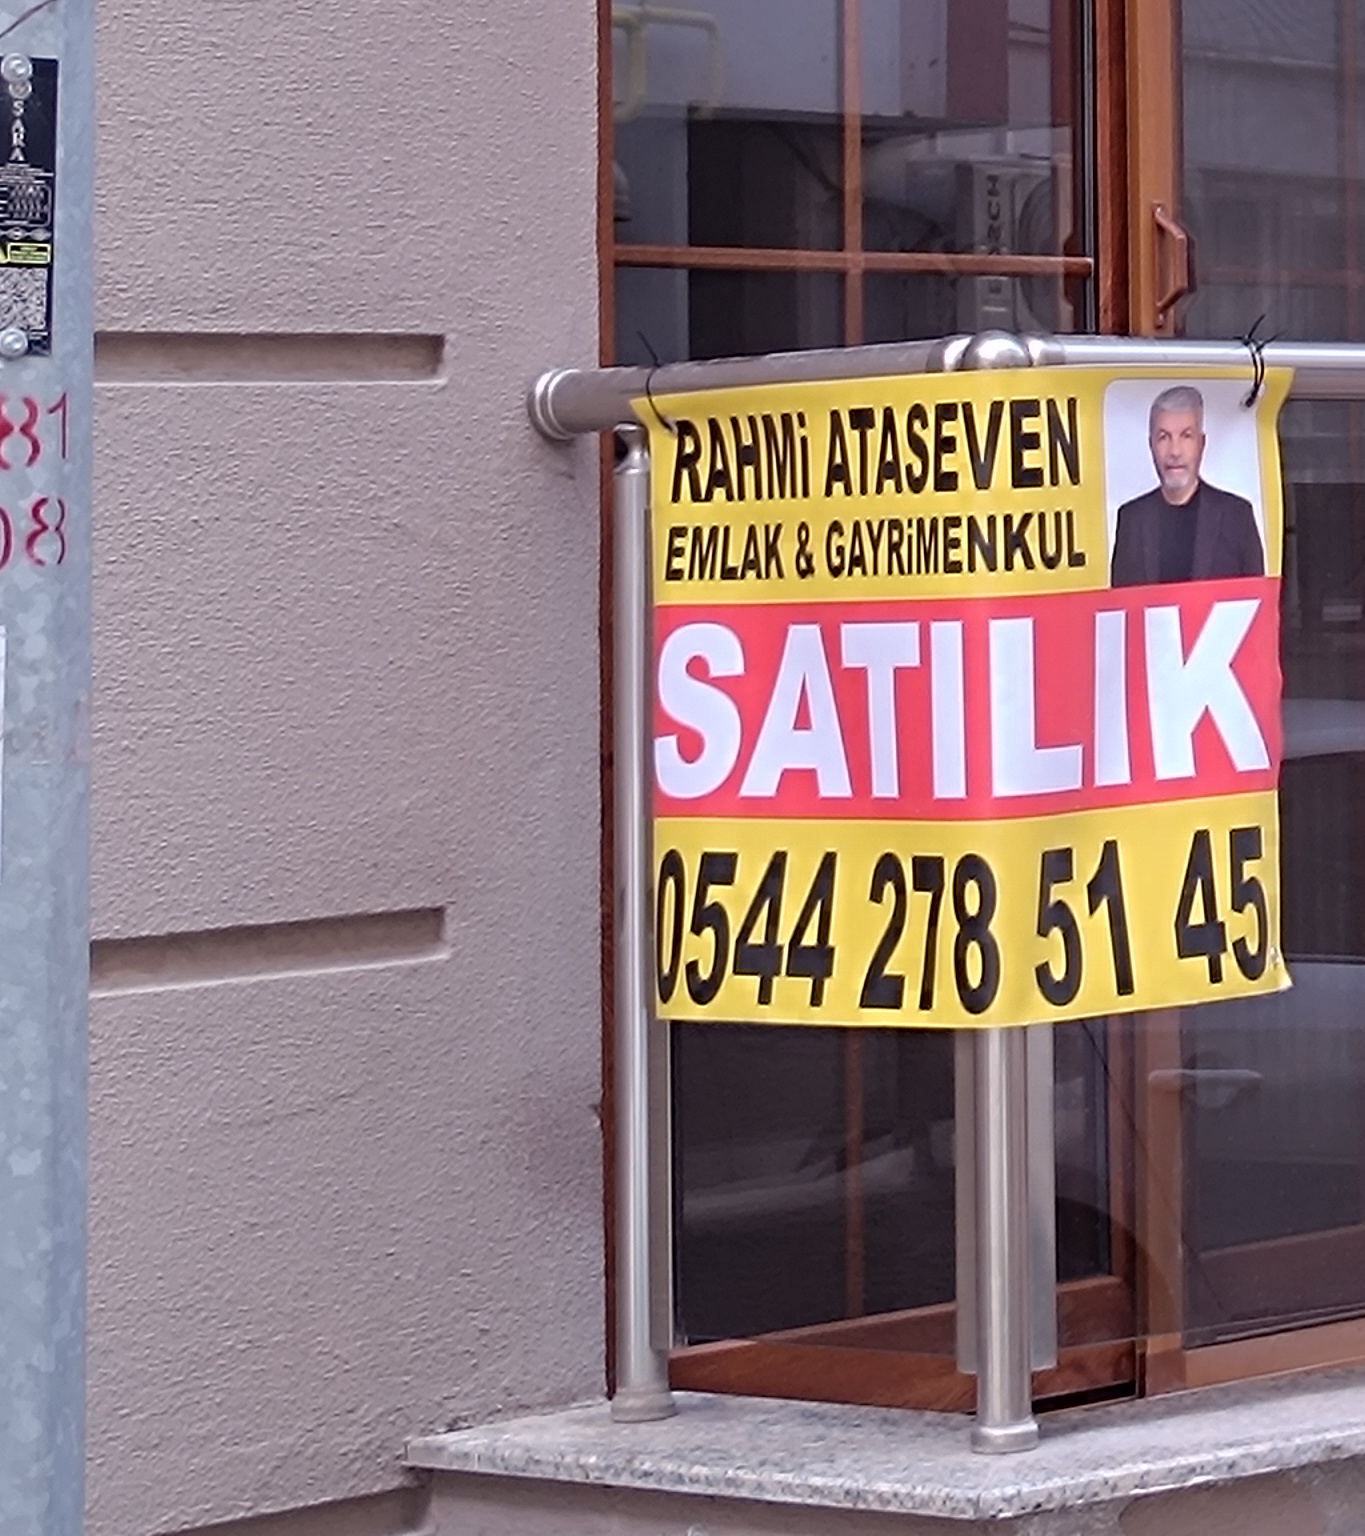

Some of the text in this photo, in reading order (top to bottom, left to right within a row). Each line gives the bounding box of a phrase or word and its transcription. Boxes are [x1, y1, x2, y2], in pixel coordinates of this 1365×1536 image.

[824, 397, 1081, 498] ATASEVEN
[665, 523, 784, 581] EMLAK
[795, 521, 816, 580] &
[654, 598, 1270, 799] SATILIK
[656, 826, 1270, 1015] 0544 278 51 45
